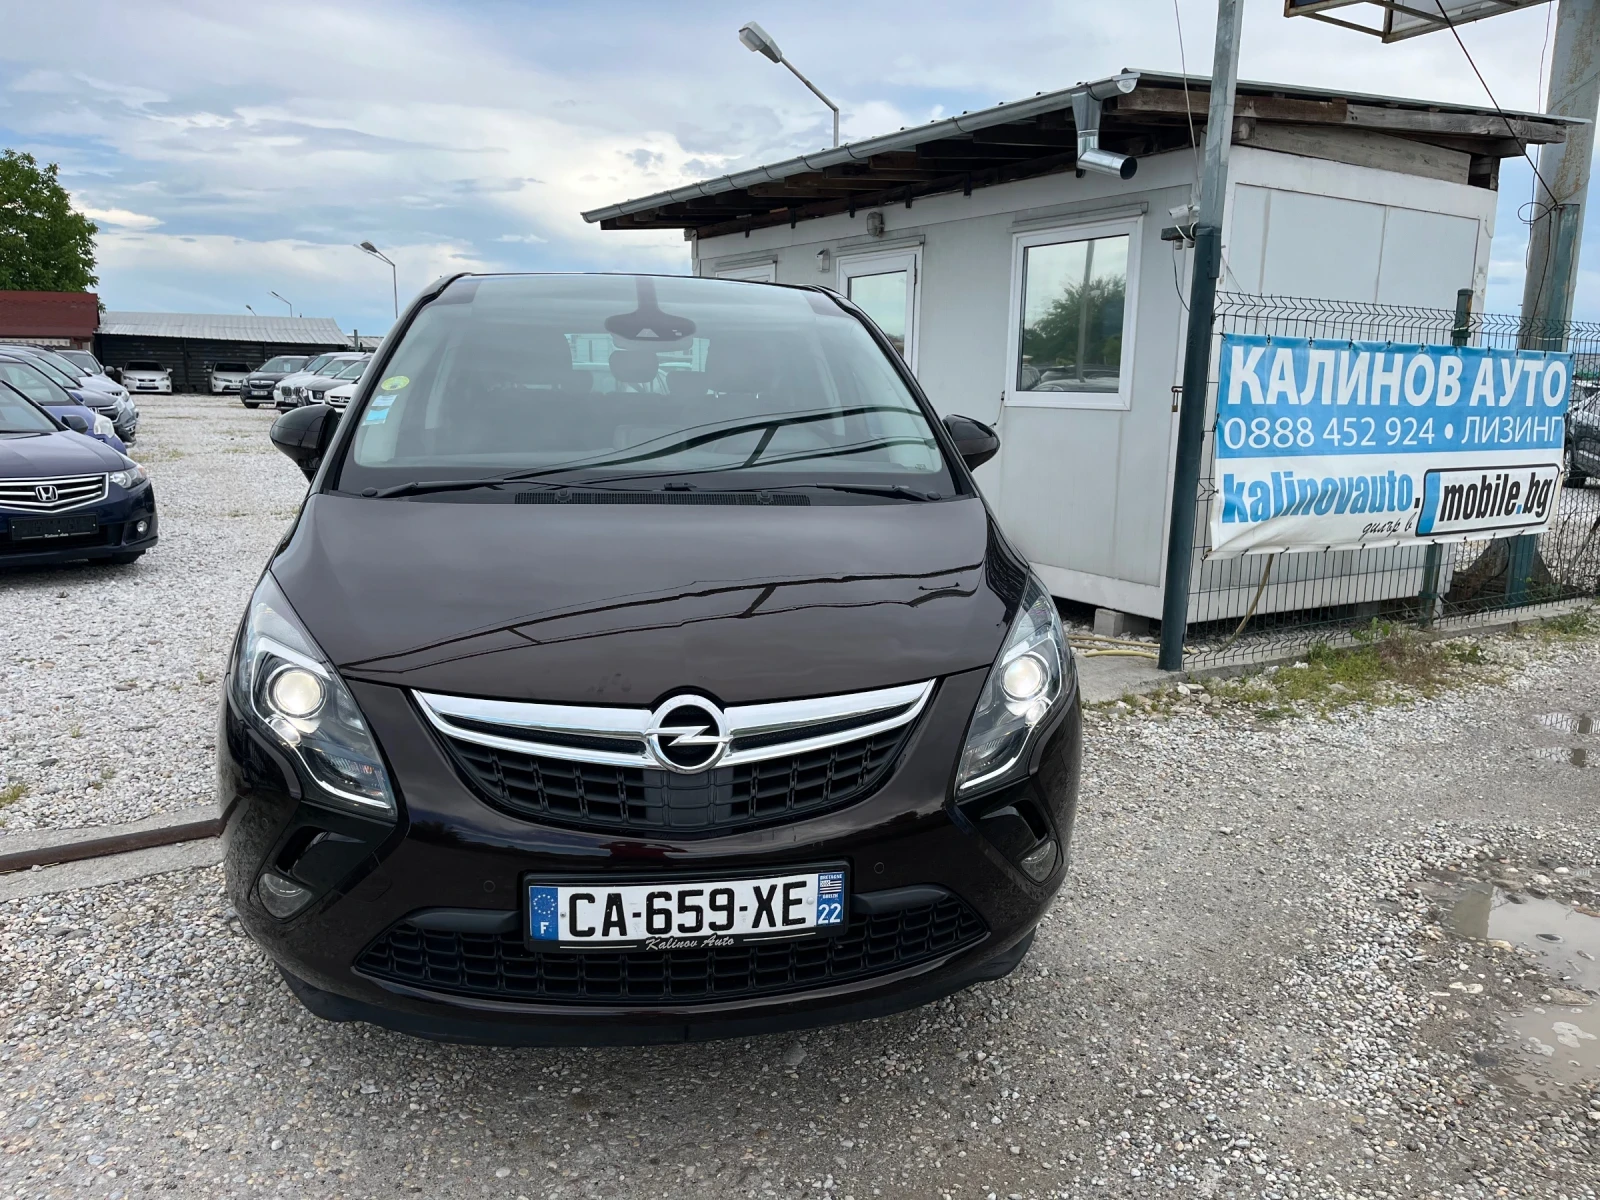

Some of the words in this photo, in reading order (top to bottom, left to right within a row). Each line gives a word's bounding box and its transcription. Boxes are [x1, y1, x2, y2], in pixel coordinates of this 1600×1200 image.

[1227, 345, 1464, 407] КАЛИНОВ
[1468, 357, 1567, 407] АУТО
[1223, 416, 1315, 449] 0888
[1323, 416, 1377, 447] 452
[1385, 416, 1436, 445] 924
[1461, 415, 1562, 444] ЛИЗИНГ
[1439, 472, 1554, 523] mobile.bg
[568, 881, 808, 937] CA-659-XE
[817, 902, 842, 925] 22
[539, 922, 549, 935] F
[645, 936, 698, 951] Kalinov
[700, 934, 735, 948] Auto
